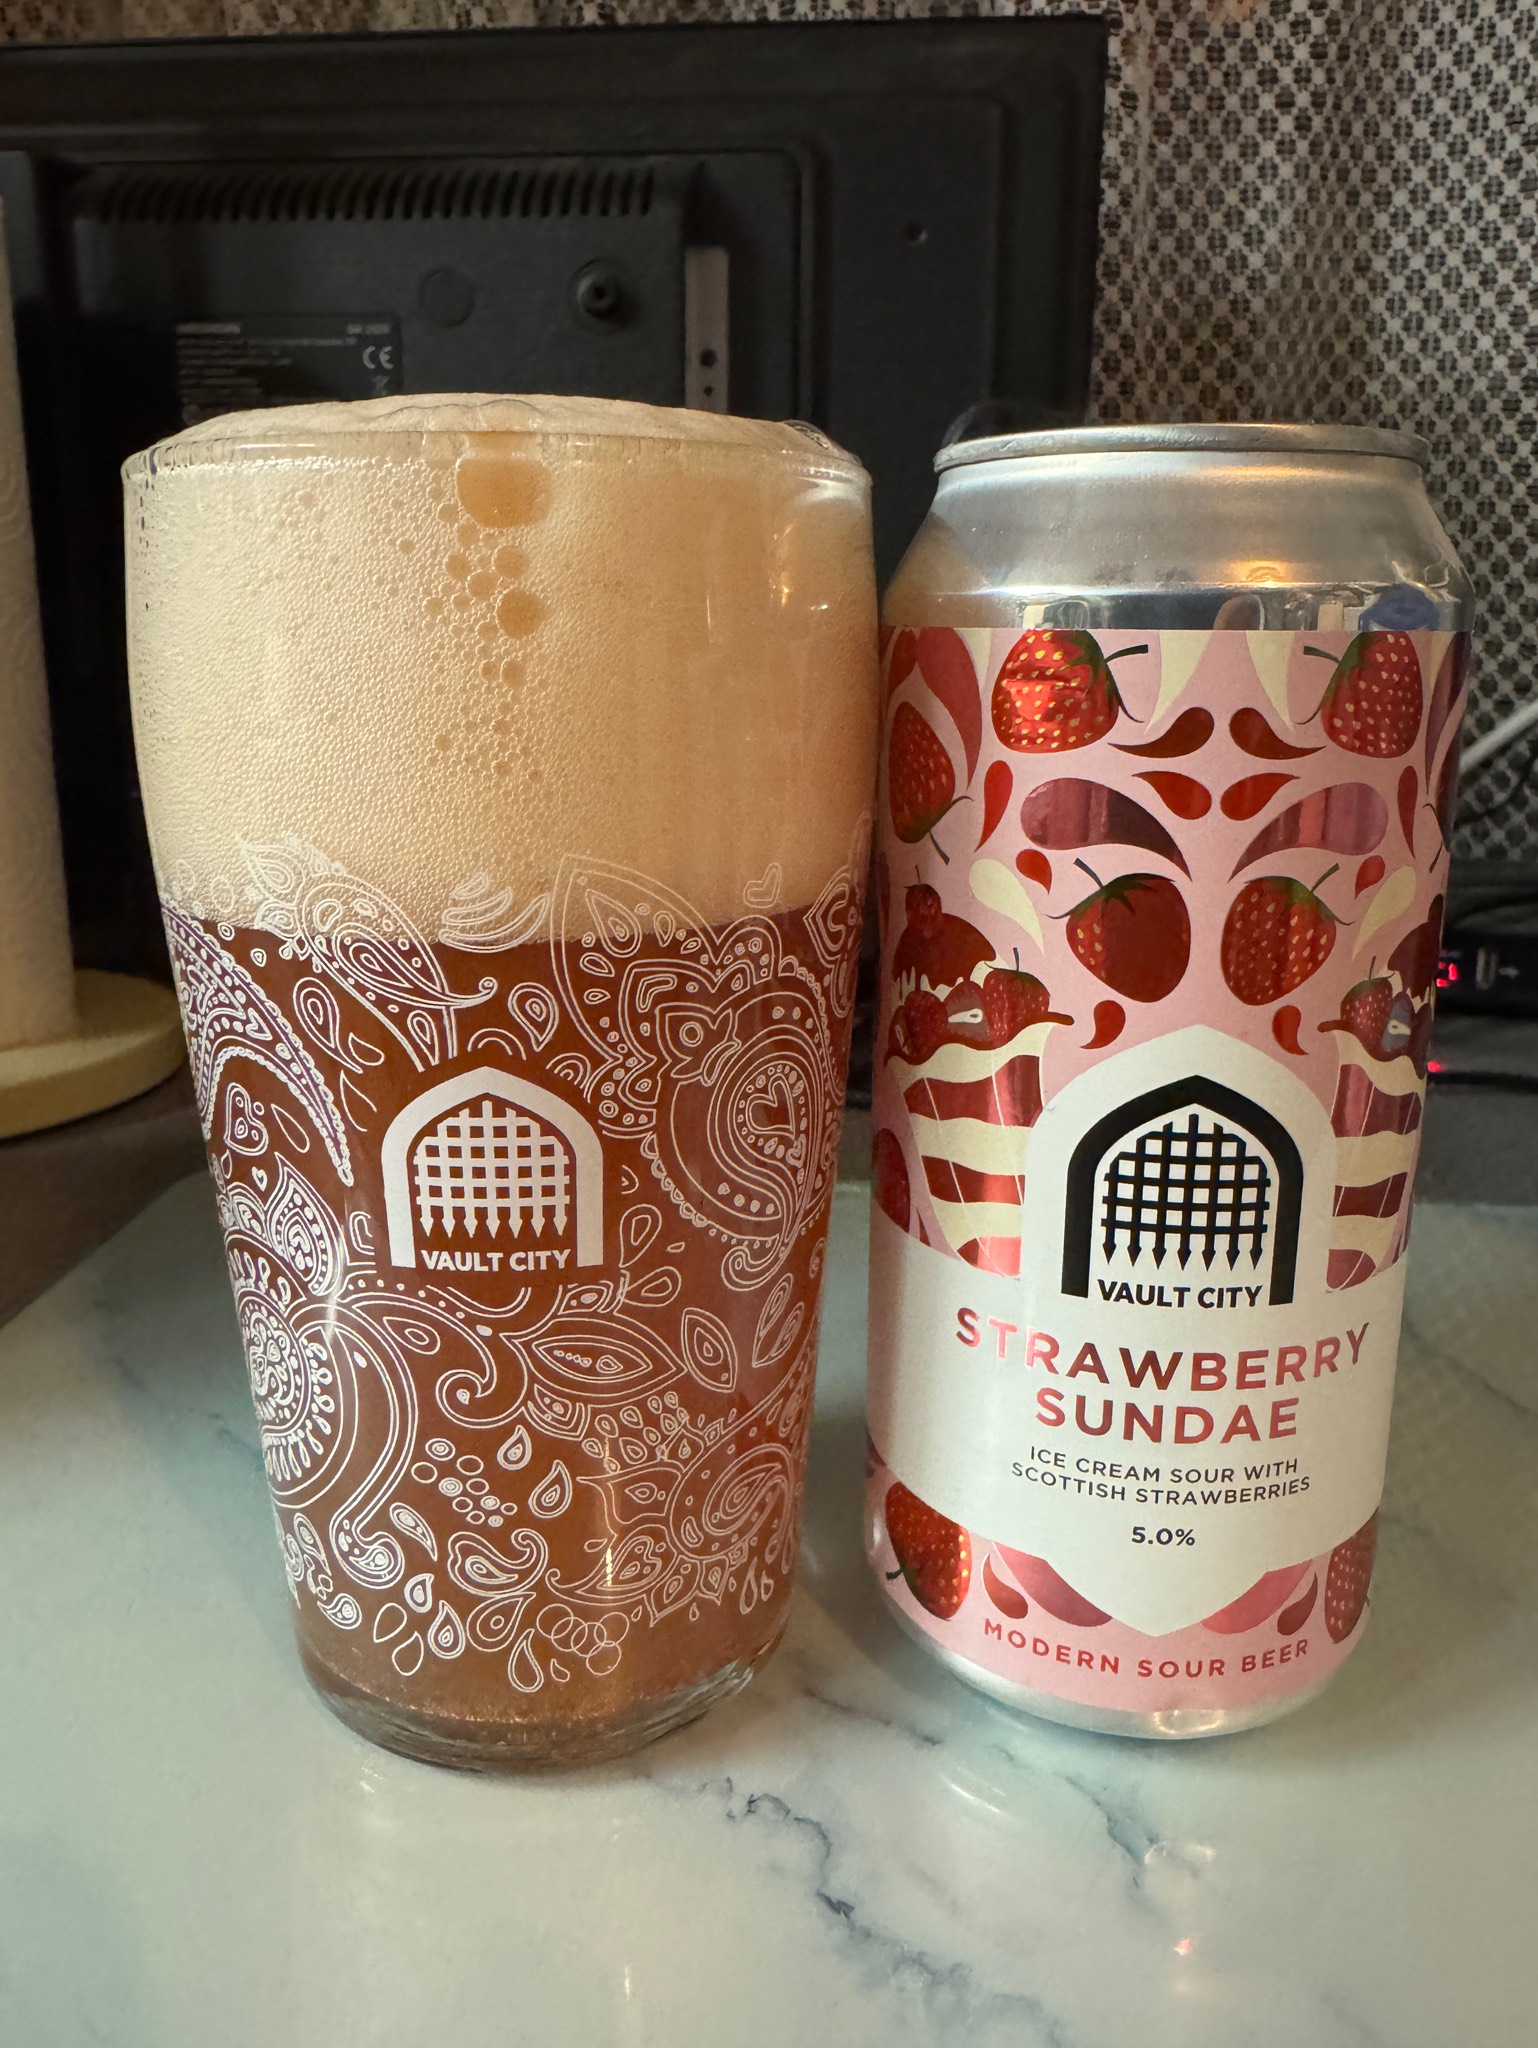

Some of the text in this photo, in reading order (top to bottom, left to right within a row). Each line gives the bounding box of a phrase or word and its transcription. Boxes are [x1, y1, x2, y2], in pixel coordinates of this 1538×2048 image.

[420, 1248, 571, 1272] VAULT CITY
[1097, 1279, 1264, 1309] VAULT CITY
[956, 1307, 1370, 1392] STRAWBERRY
[1035, 1387, 1300, 1444] SUNDAE
[1012, 1462, 1310, 1506] SCOTTISH STRAWBERRIES
[1030, 1446, 1298, 1484] ICE CREAM SOUR WITH
[1131, 1526, 1196, 1546] 5.0%
[984, 1618, 1308, 1679] MODERN SOUR BEER
